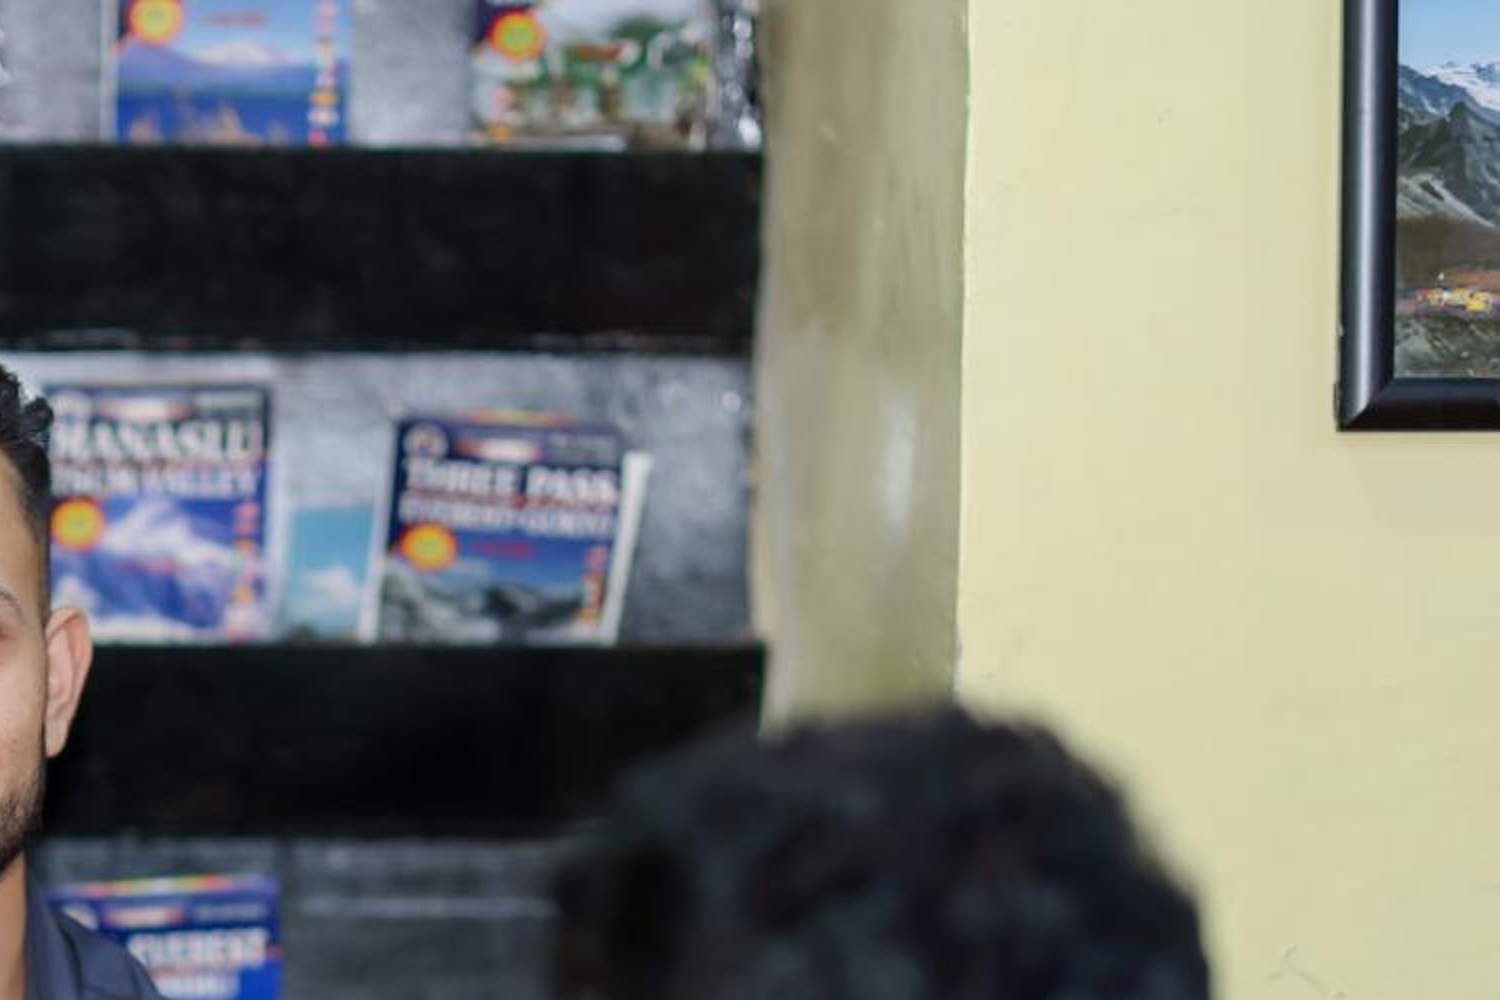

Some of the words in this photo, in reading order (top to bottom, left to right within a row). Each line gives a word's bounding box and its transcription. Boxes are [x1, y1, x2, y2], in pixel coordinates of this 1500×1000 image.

[52, 418, 262, 457] MANASLU
[407, 458, 517, 496] THREE
[526, 466, 617, 503] PASS
